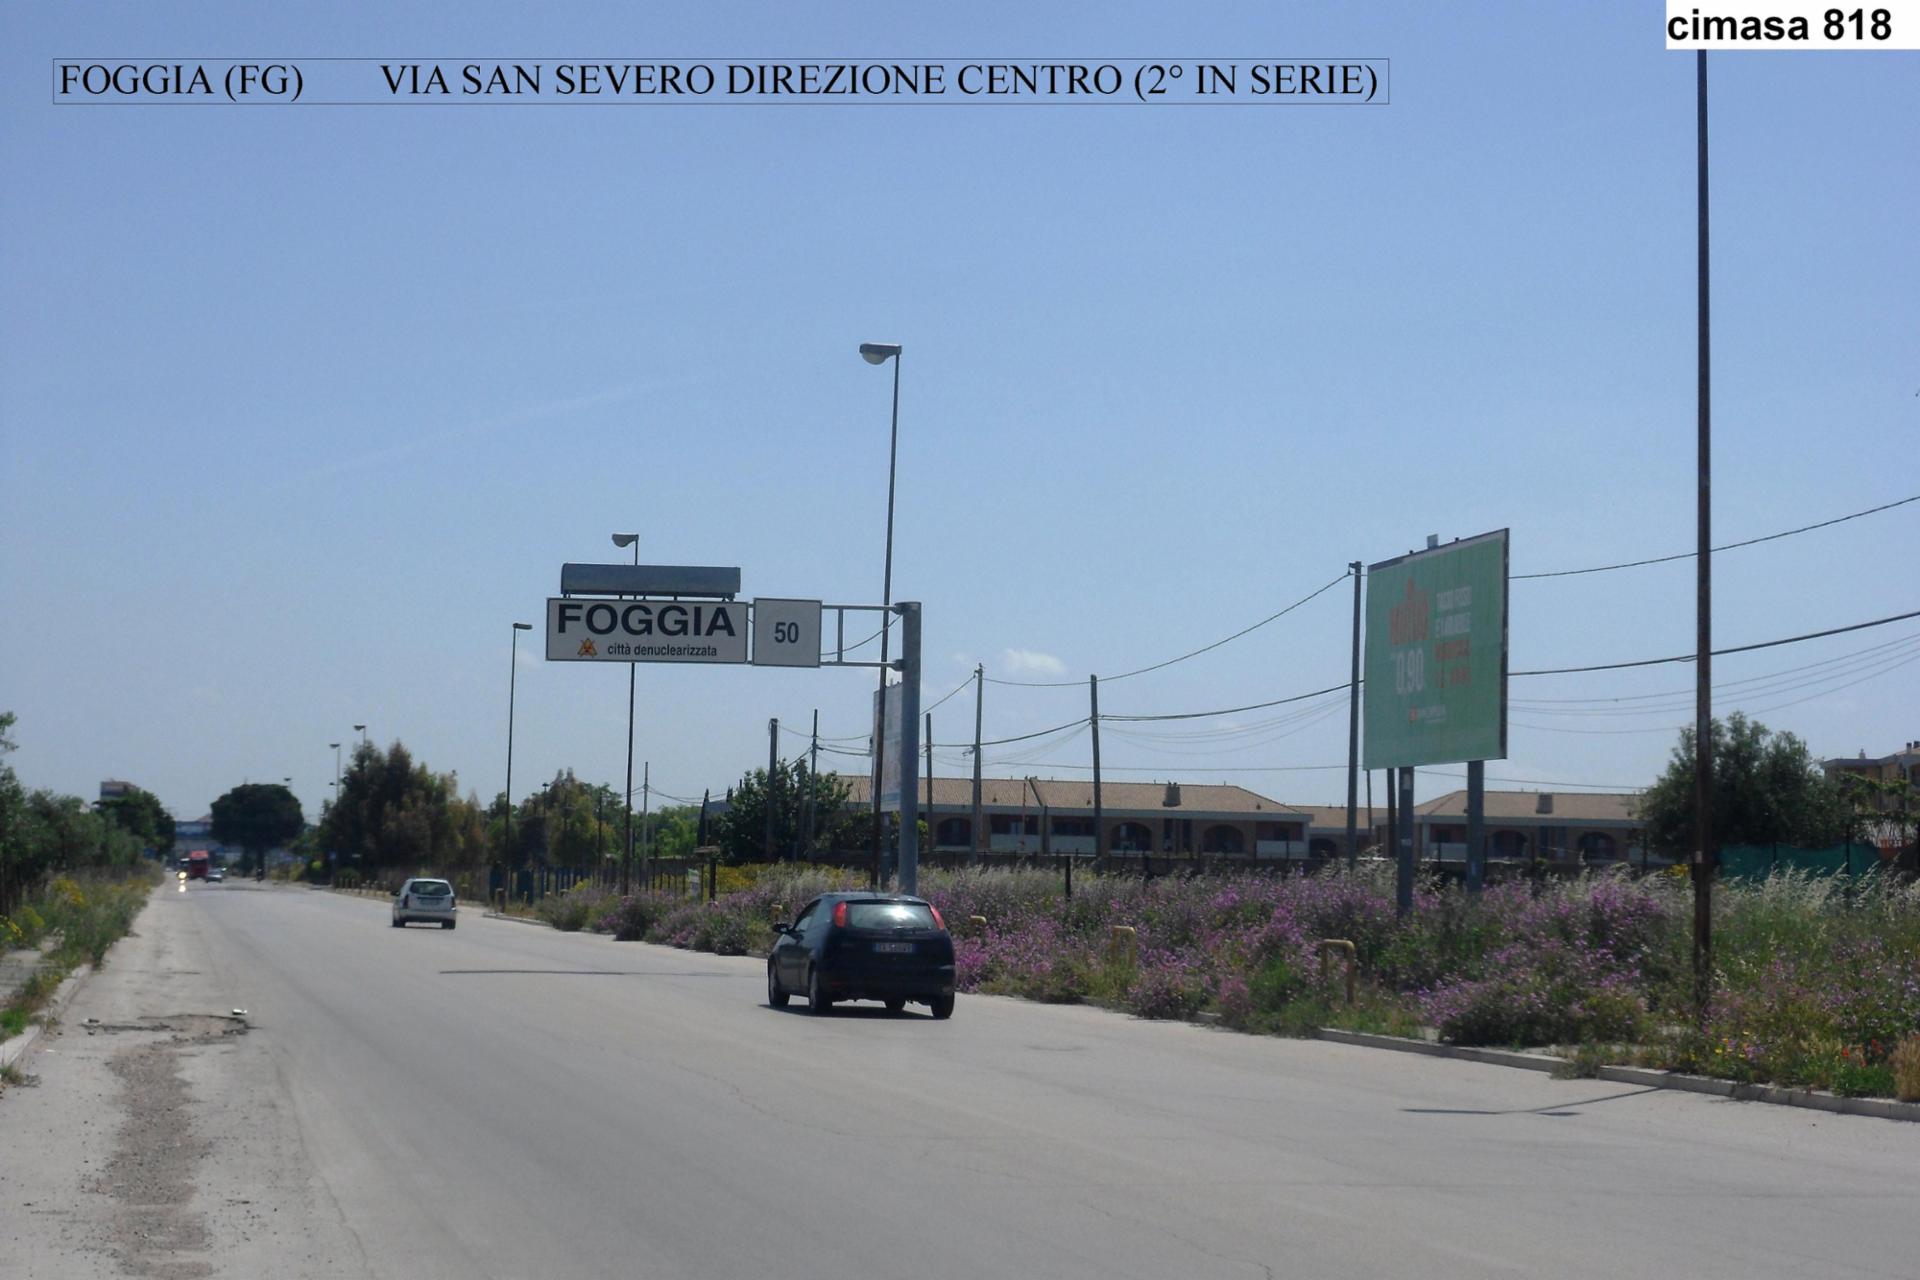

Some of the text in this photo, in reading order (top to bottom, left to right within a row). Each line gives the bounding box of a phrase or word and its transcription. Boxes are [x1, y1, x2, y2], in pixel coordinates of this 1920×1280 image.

[558, 603, 736, 637] FOGGIA
[774, 621, 800, 644] 50
[607, 642, 718, 657] città denuclearizzata
